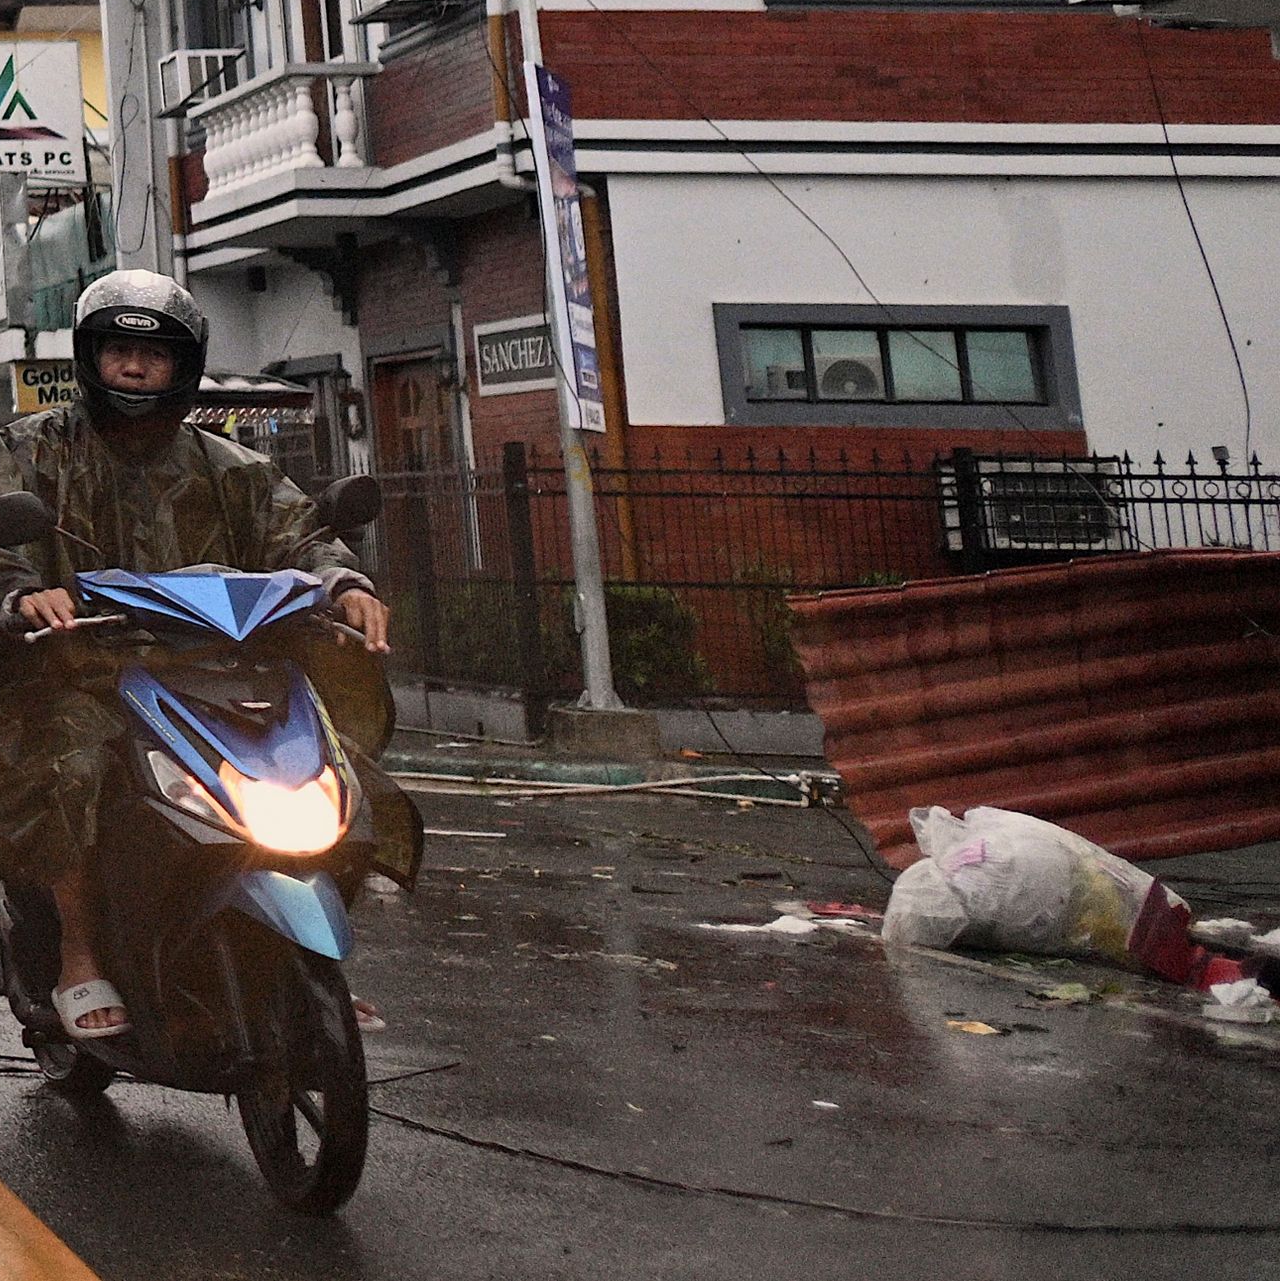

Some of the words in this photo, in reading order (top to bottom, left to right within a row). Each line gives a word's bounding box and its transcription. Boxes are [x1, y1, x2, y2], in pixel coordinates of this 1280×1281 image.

[44, 152, 72, 166] PC
[482, 336, 546, 374] SANCHEZ
[38, 385, 78, 405] Ma
